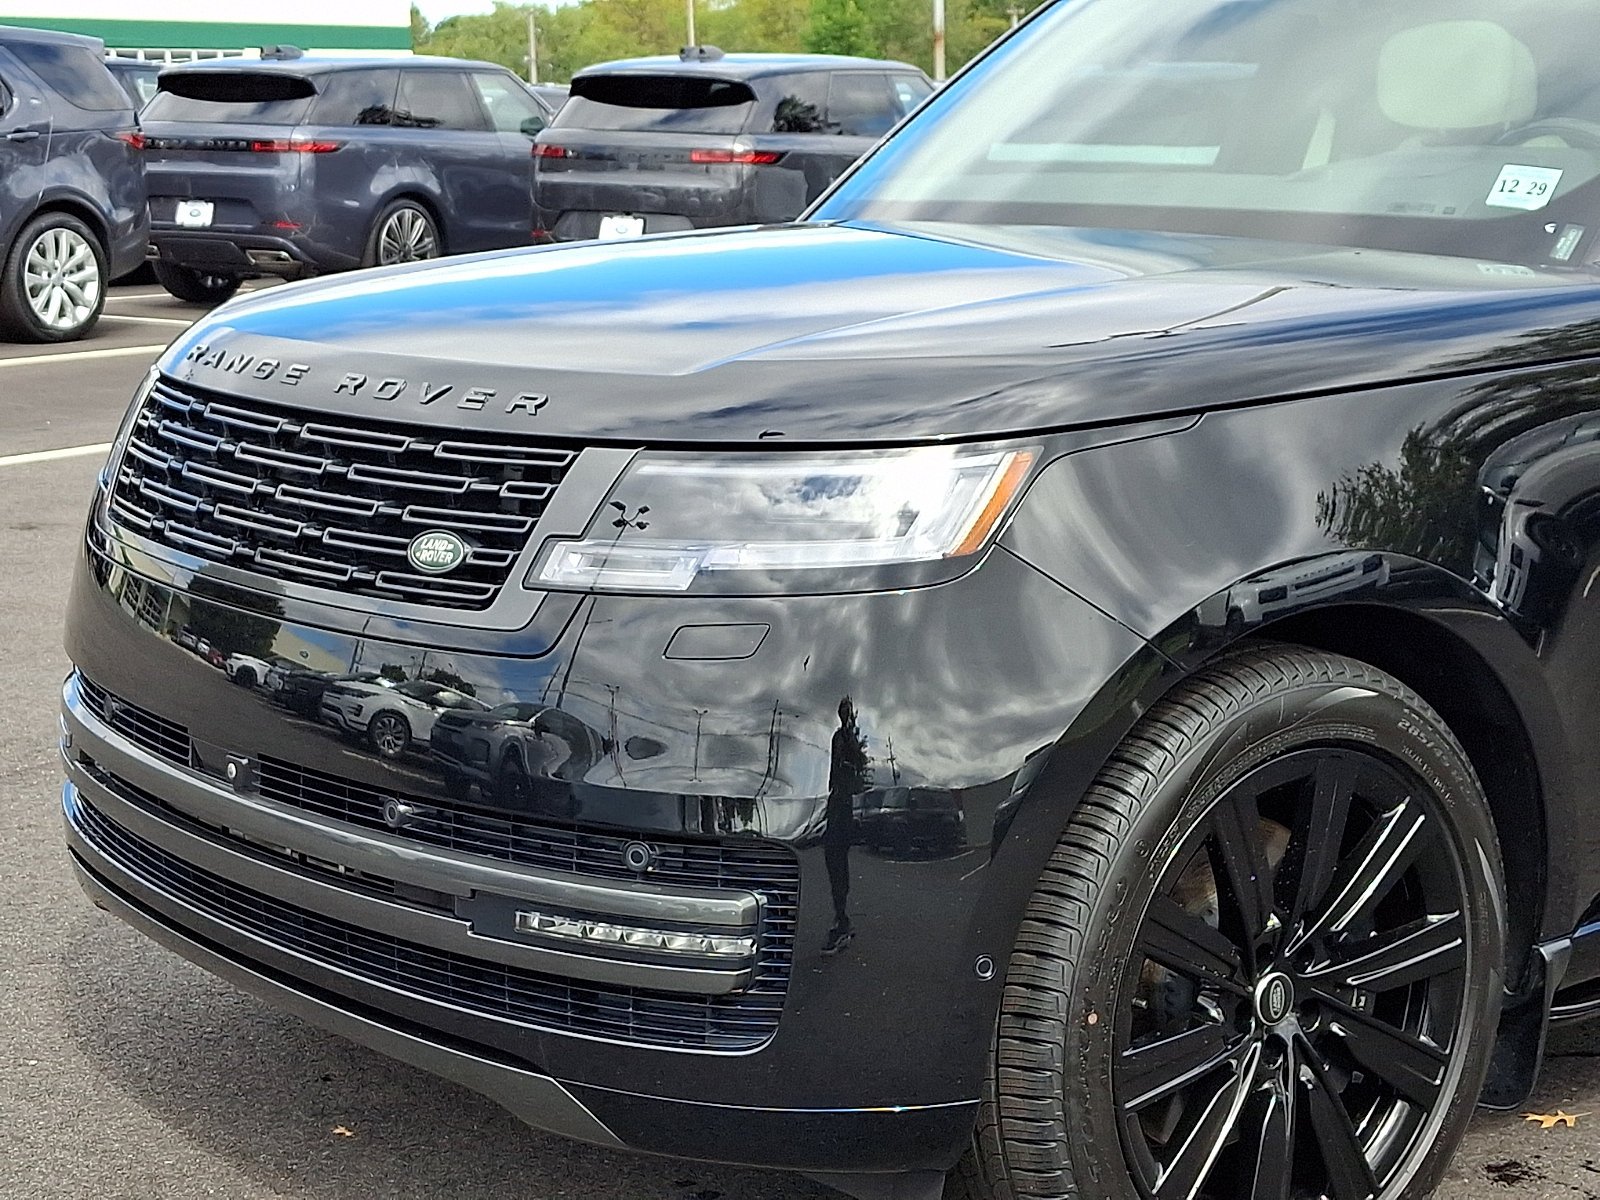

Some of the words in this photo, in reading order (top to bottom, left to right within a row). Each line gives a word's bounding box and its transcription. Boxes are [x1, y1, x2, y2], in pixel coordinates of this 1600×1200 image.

[1498, 179, 1520, 193] 12
[1526, 181, 1548, 196] 29
[186, 343, 310, 385] RANGE
[333, 372, 551, 417] ROVER
[420, 538, 450, 551] LAND
[419, 549, 454, 563] ROVER
